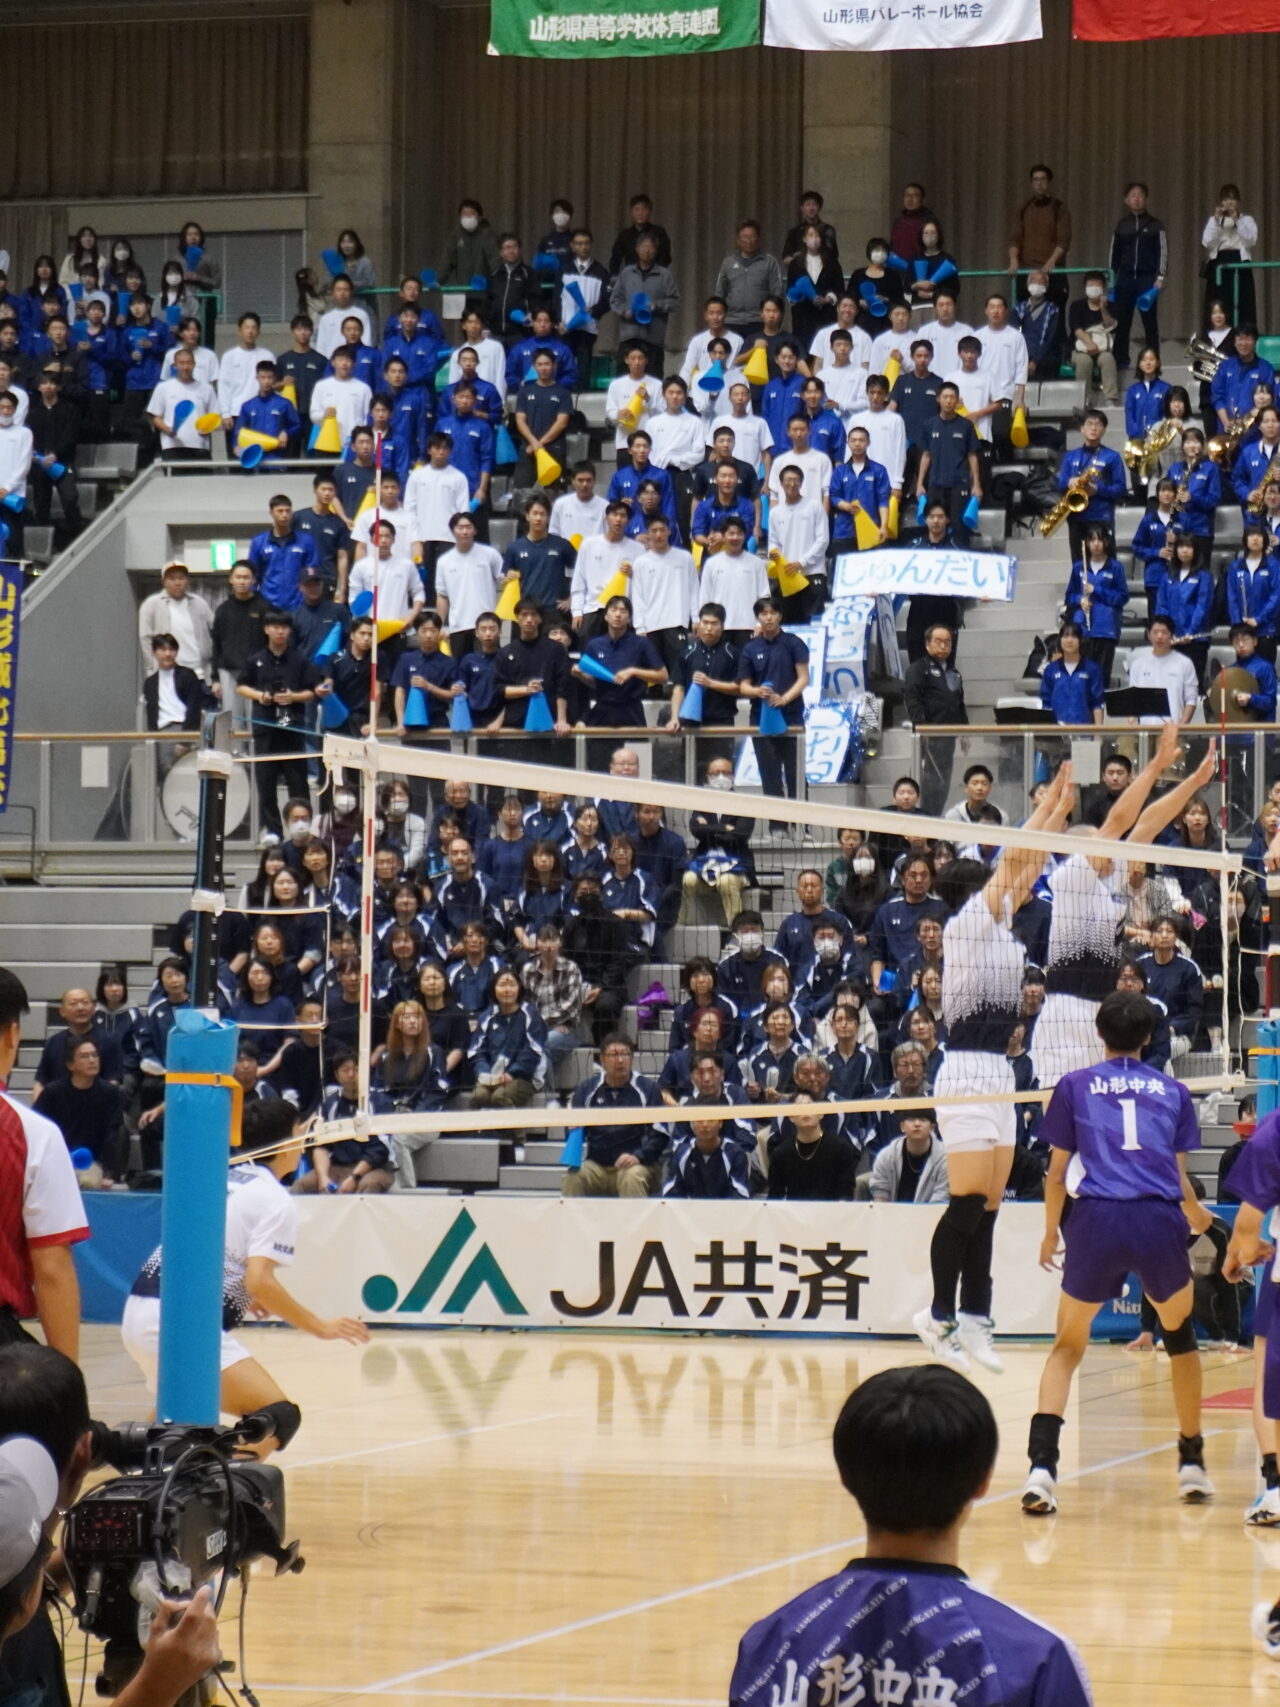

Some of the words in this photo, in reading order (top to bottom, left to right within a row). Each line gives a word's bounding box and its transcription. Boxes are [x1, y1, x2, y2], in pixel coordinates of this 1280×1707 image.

[529, 8, 721, 42] 山形県高等学校体育連盟
[822, 3, 984, 24] 山形県バレーボール協会
[839, 553, 1006, 588] じゅんだい
[1089, 1076, 1167, 1096] 山形中央
[1117, 1099, 1142, 1150] 1
[549, 1240, 870, 1321] JA共済
[845, 1594, 886, 1629] YAMAGATA
[771, 1652, 960, 1707] 山形中央
